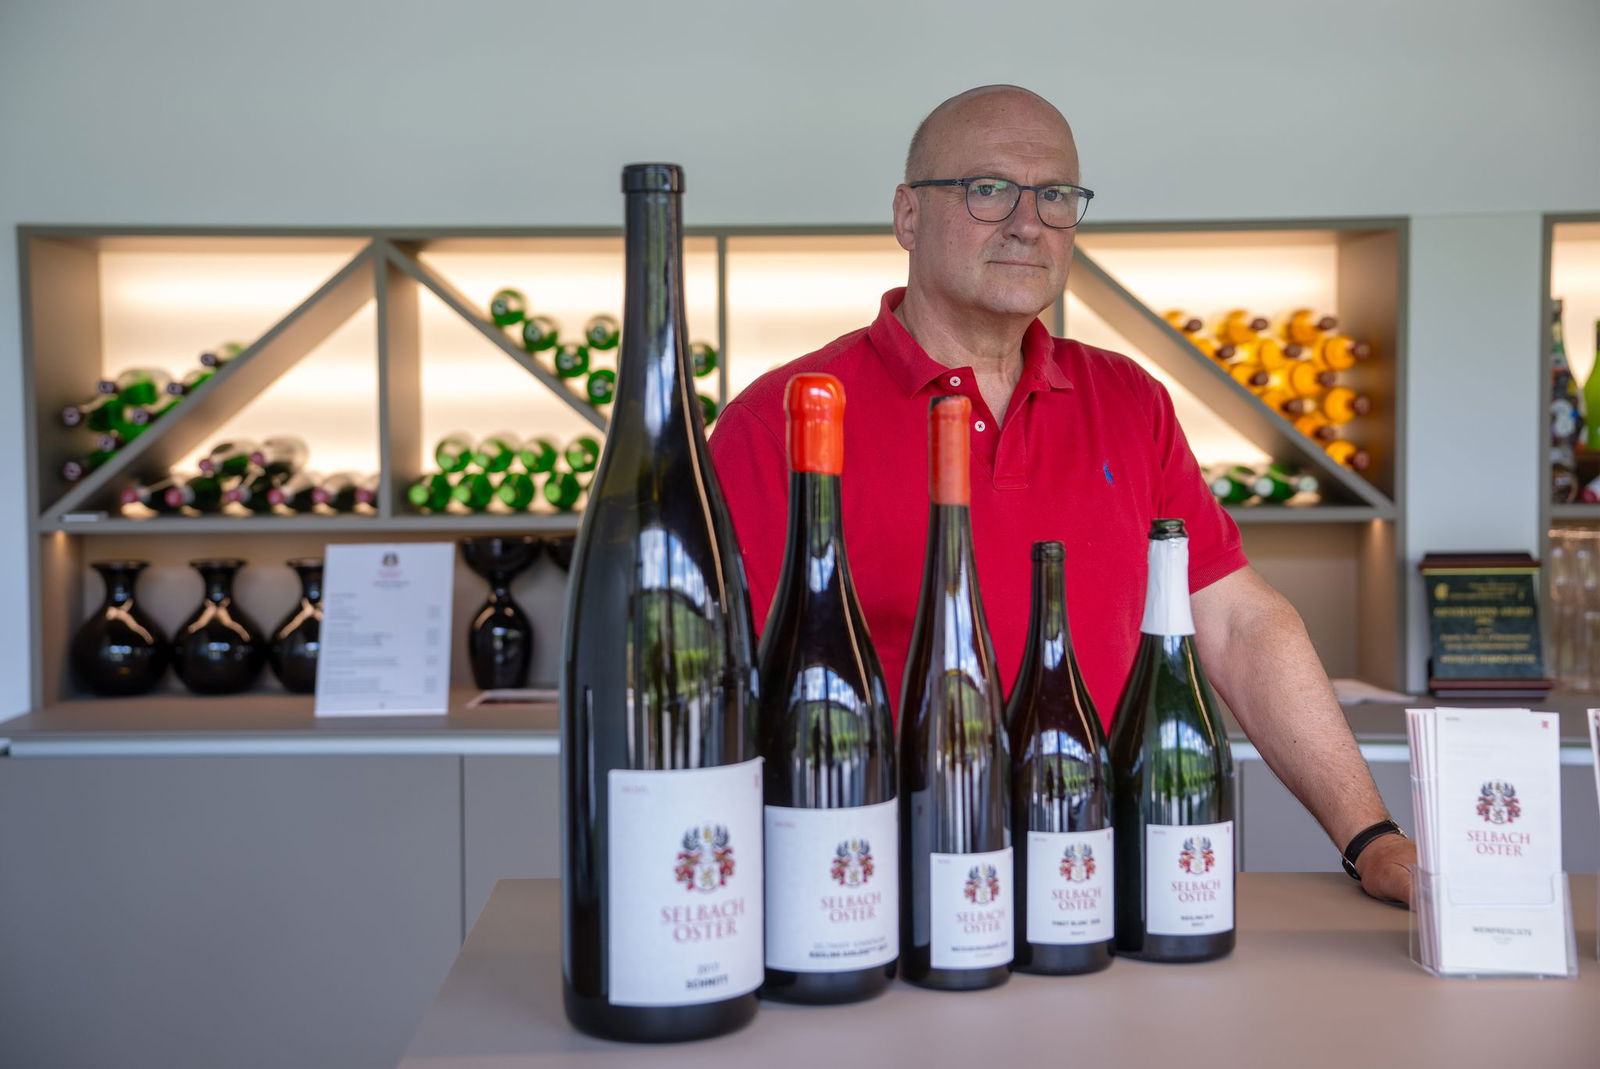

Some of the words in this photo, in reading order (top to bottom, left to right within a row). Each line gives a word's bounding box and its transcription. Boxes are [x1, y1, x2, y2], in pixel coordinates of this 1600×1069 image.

[1466, 830, 1531, 845] SELBACH
[1475, 844, 1523, 857] OSTER
[1171, 880, 1221, 892] SELBACH
[821, 891, 881, 909] SELBACH
[1051, 887, 1102, 900] SELBACH
[1178, 891, 1216, 903] OSTER
[660, 898, 744, 924] SELBACH
[1058, 899, 1097, 911] OSTER
[829, 906, 877, 923] OSTER
[956, 910, 1006, 924] SELBACH
[673, 918, 738, 943] OSTER
[963, 920, 1001, 934] OSTER
